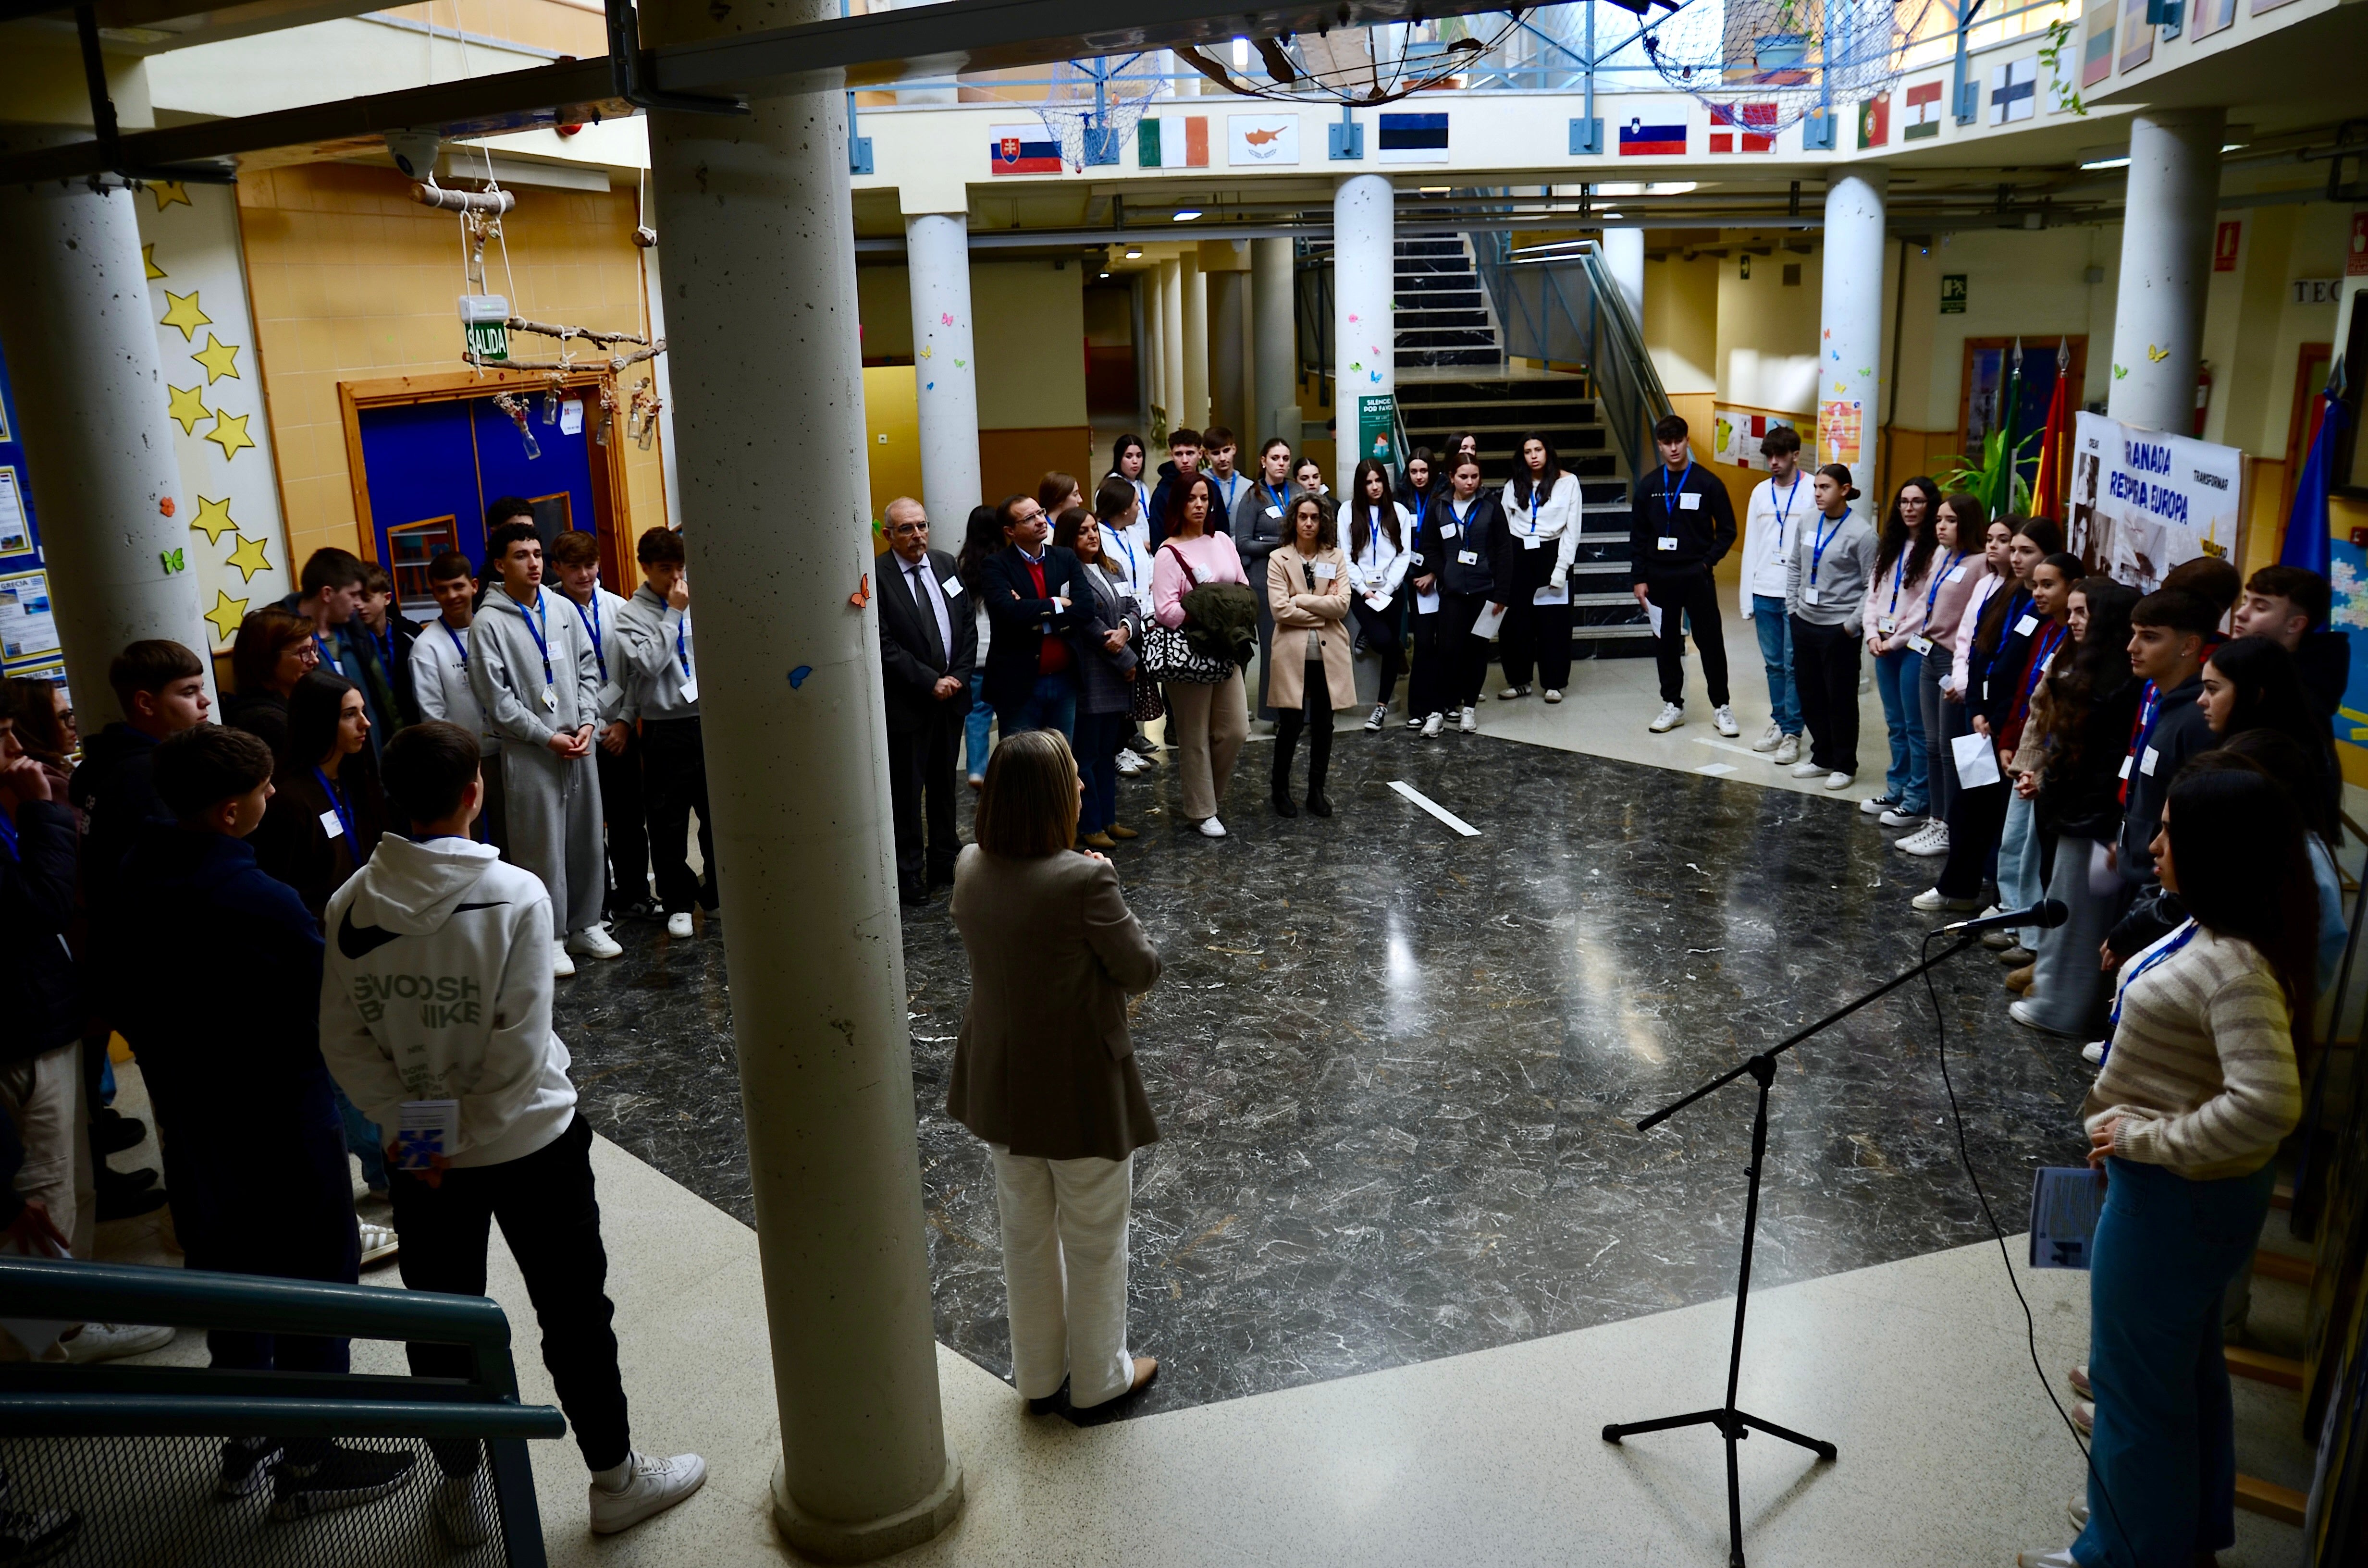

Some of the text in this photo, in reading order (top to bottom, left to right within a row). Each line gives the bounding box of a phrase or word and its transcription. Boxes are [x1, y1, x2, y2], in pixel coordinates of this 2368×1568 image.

[468, 328, 506, 355] SALIDA
[2125, 440, 2171, 477] RANADA
[2194, 470, 2229, 491] TRANSFORMAR
[2151, 485, 2188, 525] EUROPA
[1, 579, 29, 589] GRECIA
